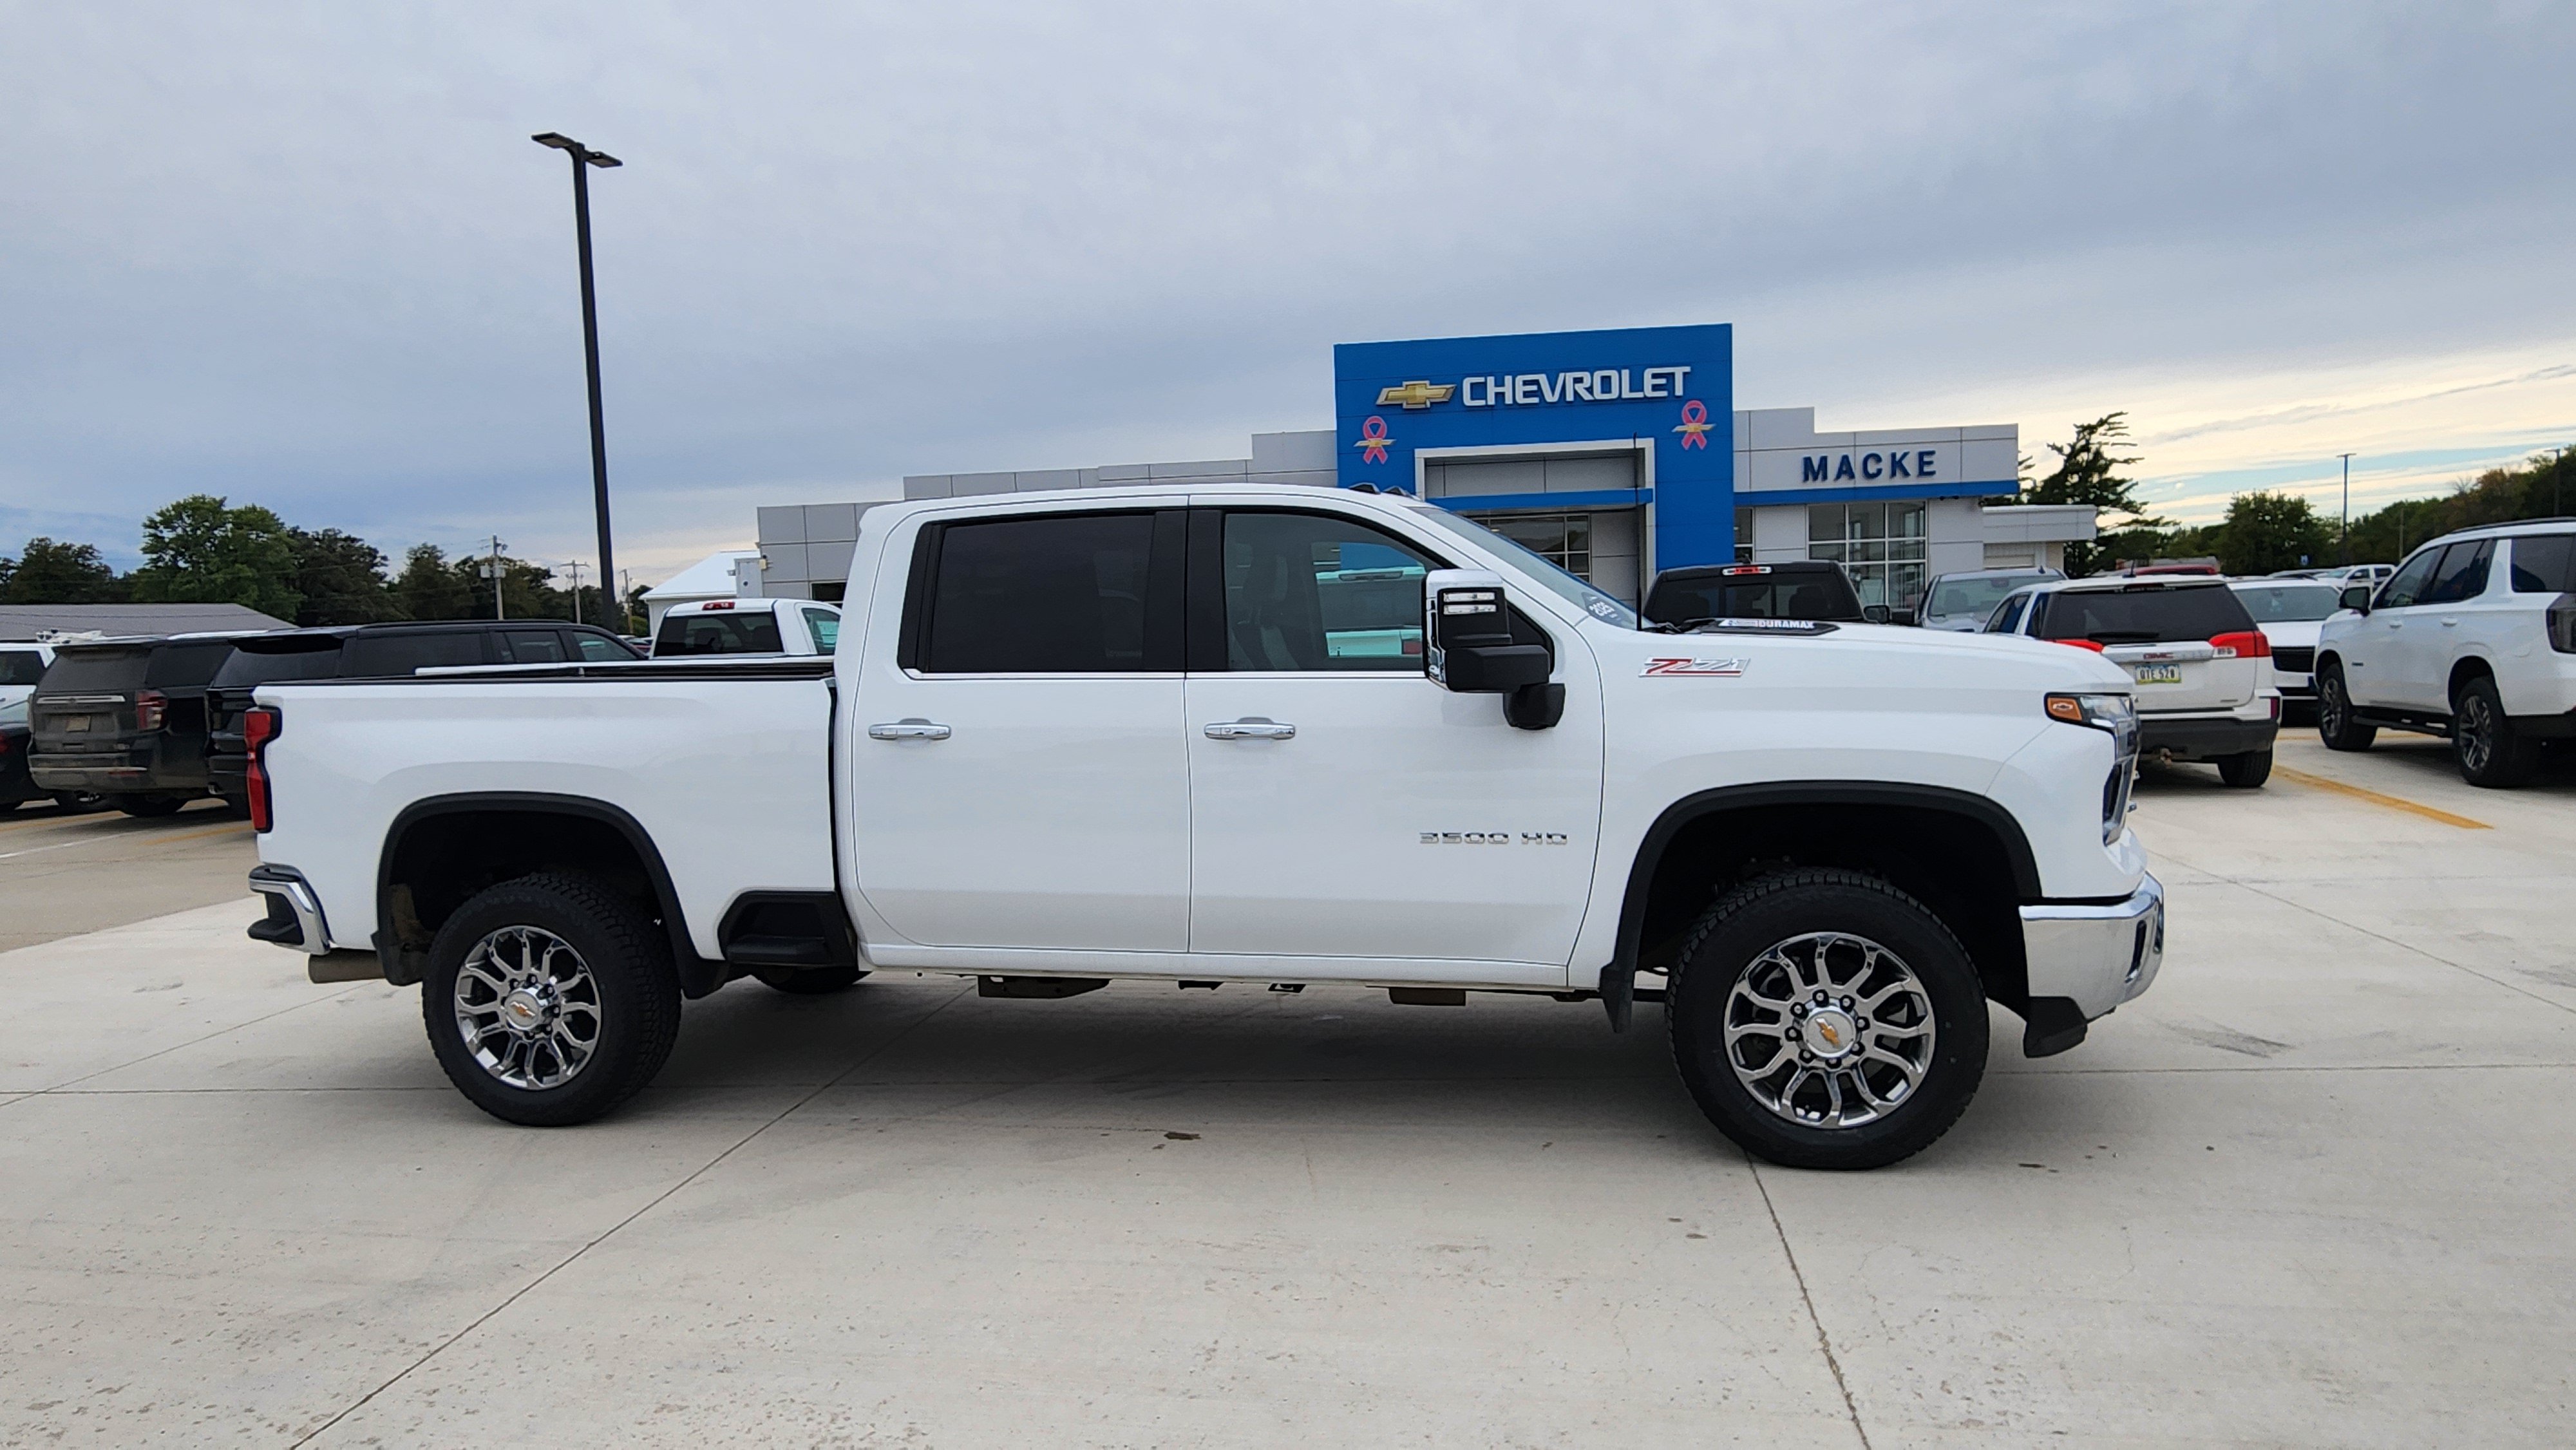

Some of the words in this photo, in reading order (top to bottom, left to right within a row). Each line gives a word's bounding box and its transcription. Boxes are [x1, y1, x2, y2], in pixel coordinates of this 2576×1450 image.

[1463, 366, 1691, 406] CHEVROLET
[1803, 450, 1936, 482] MACKE
[1757, 619, 1815, 629] DURAMAX
[1638, 657, 1750, 677] Z71
[1419, 832, 1510, 845] 3500
[1521, 832, 1567, 845] HD
